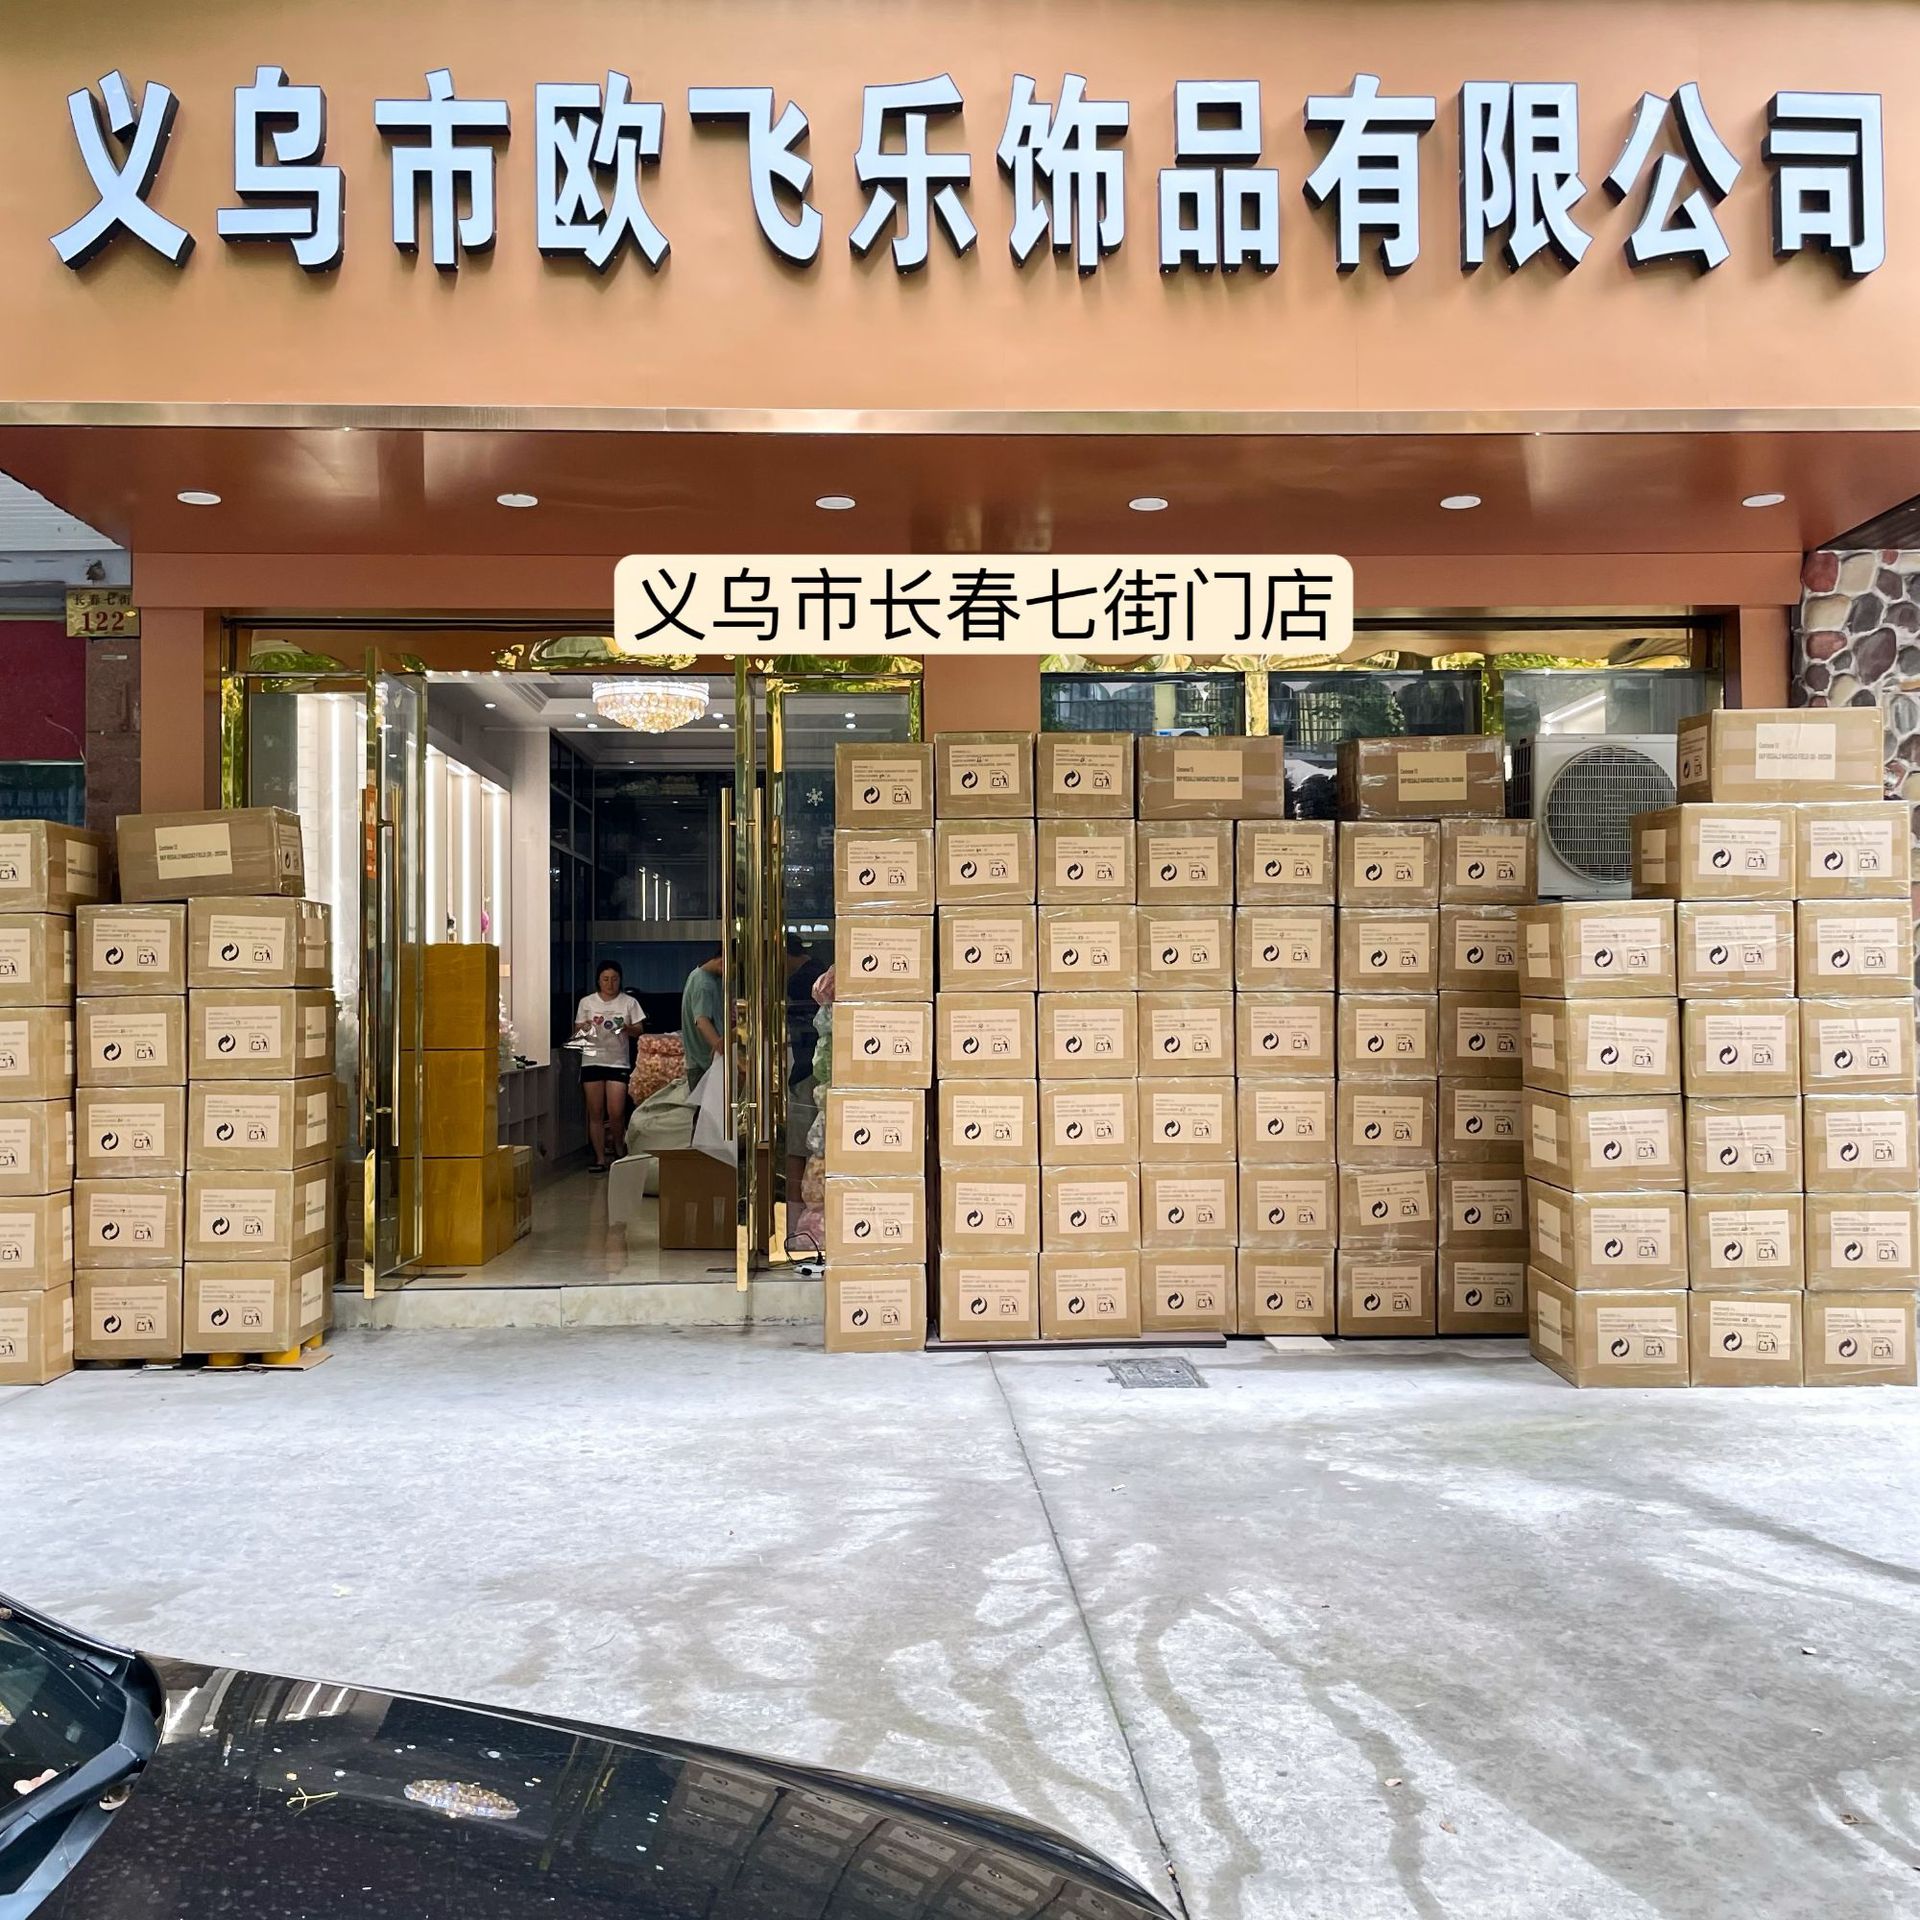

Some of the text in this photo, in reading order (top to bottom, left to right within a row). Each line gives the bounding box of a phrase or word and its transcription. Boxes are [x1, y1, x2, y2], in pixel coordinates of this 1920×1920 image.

[50, 66, 1885, 278] 义乌市欧飞乐饰品有限公司
[81, 611, 125, 632] 122
